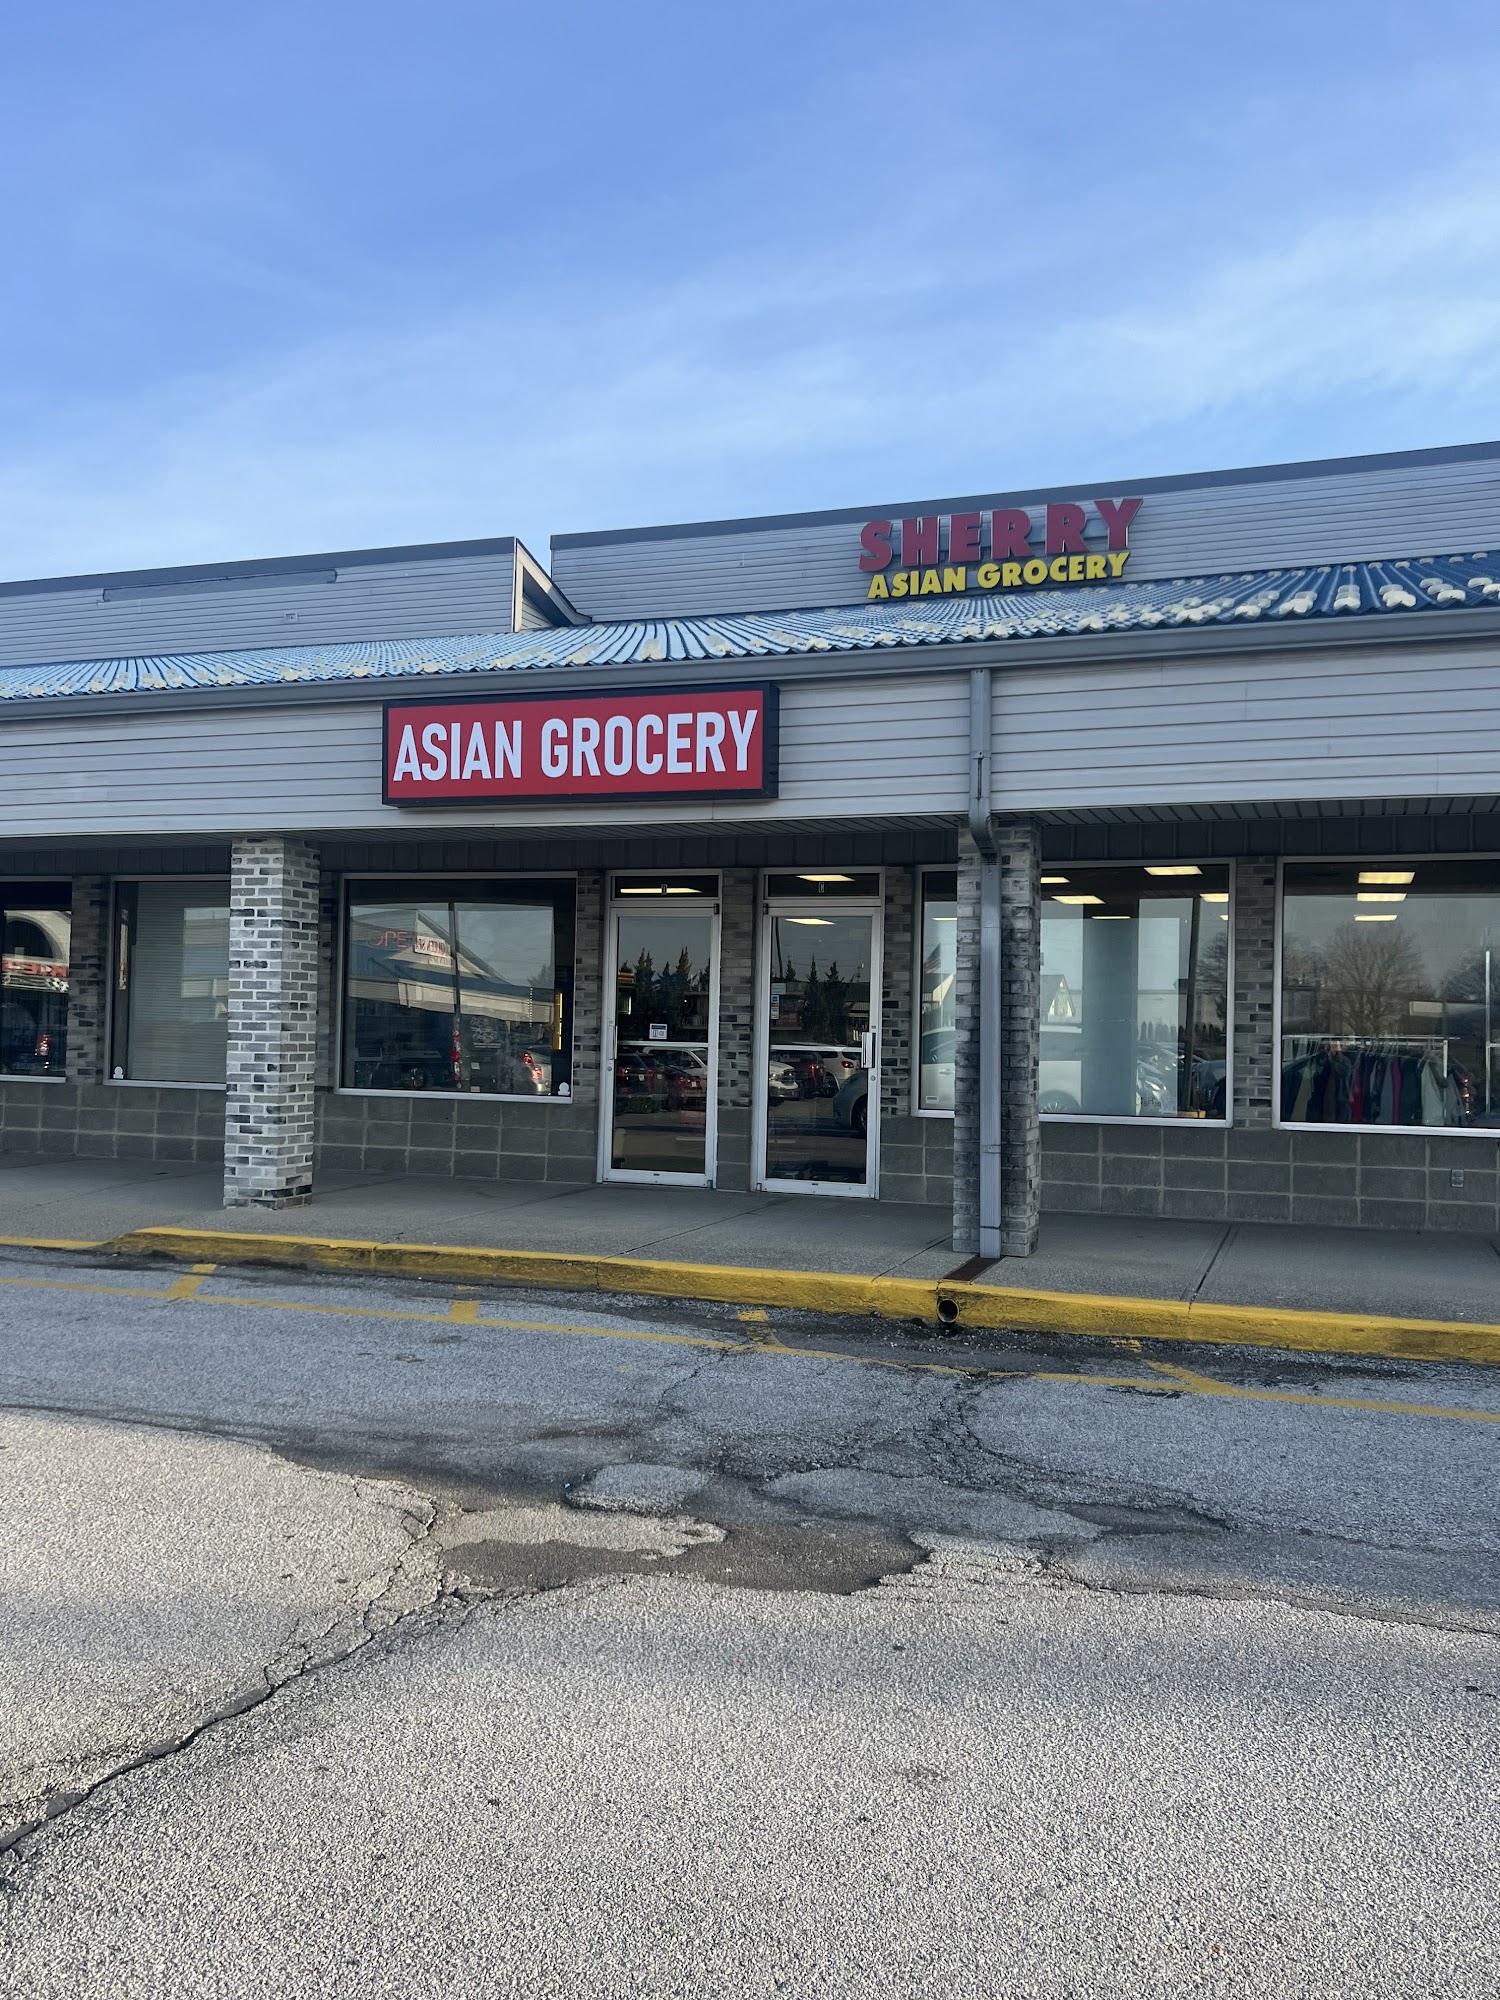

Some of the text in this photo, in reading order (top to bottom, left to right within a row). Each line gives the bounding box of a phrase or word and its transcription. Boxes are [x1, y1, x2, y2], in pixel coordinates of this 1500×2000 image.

[859, 498, 1143, 572] SHERRY
[867, 552, 1130, 599] ASIAN GROCERY
[393, 710, 758, 782] ASIAN GROCERY
